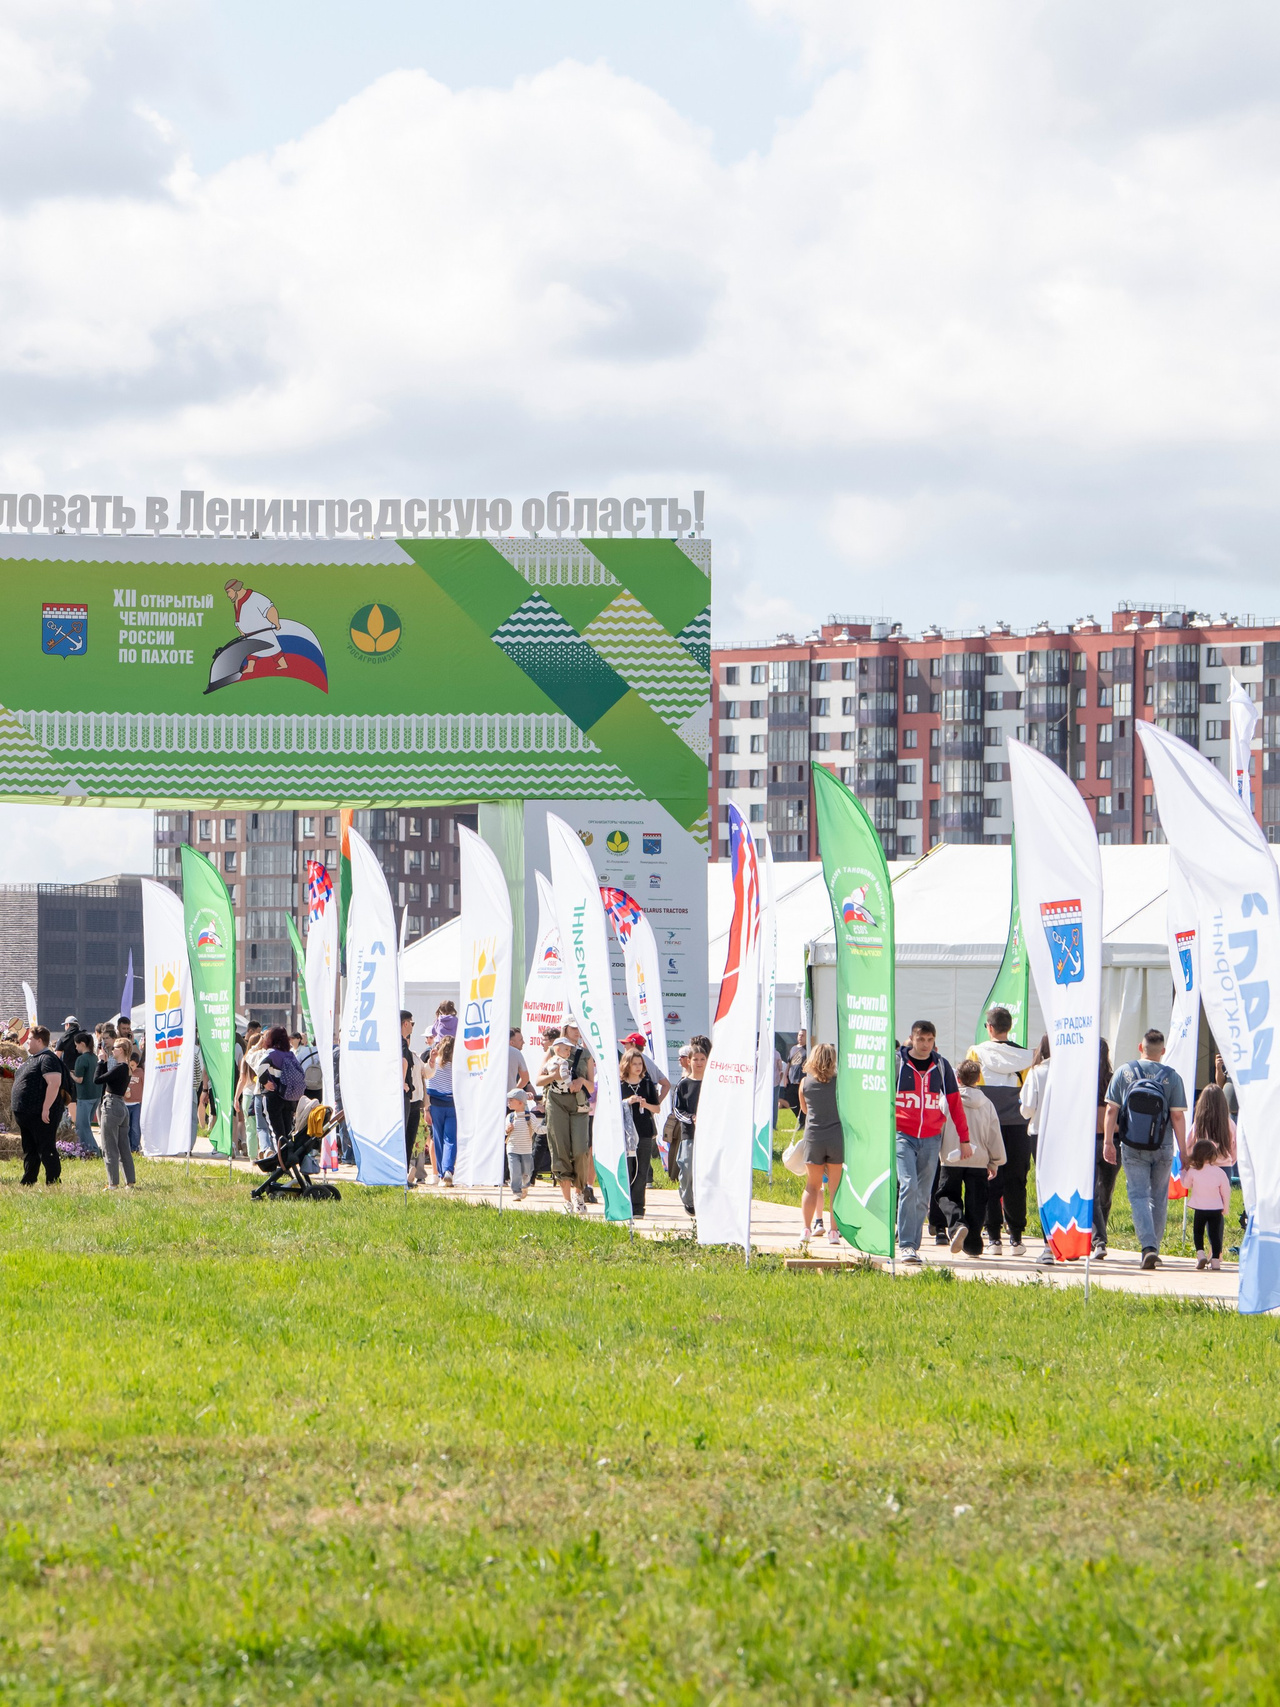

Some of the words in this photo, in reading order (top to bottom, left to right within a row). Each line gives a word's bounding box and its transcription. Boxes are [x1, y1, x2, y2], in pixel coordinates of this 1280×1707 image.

[145, 496, 169, 531] в
[177, 490, 513, 537] Ленинградскую
[522, 490, 705, 535] область!
[113, 589, 137, 607] XII
[140, 594, 214, 608] ОТКРЫТЫЙ
[119, 611, 204, 626] ЧЕМПИОНАТ
[119, 630, 175, 645] РОССИИ
[119, 649, 137, 663] ПО
[141, 649, 194, 664] ПАХОТЕ
[347, 644, 403, 665] РОСАГРОЛИЗИНГ
